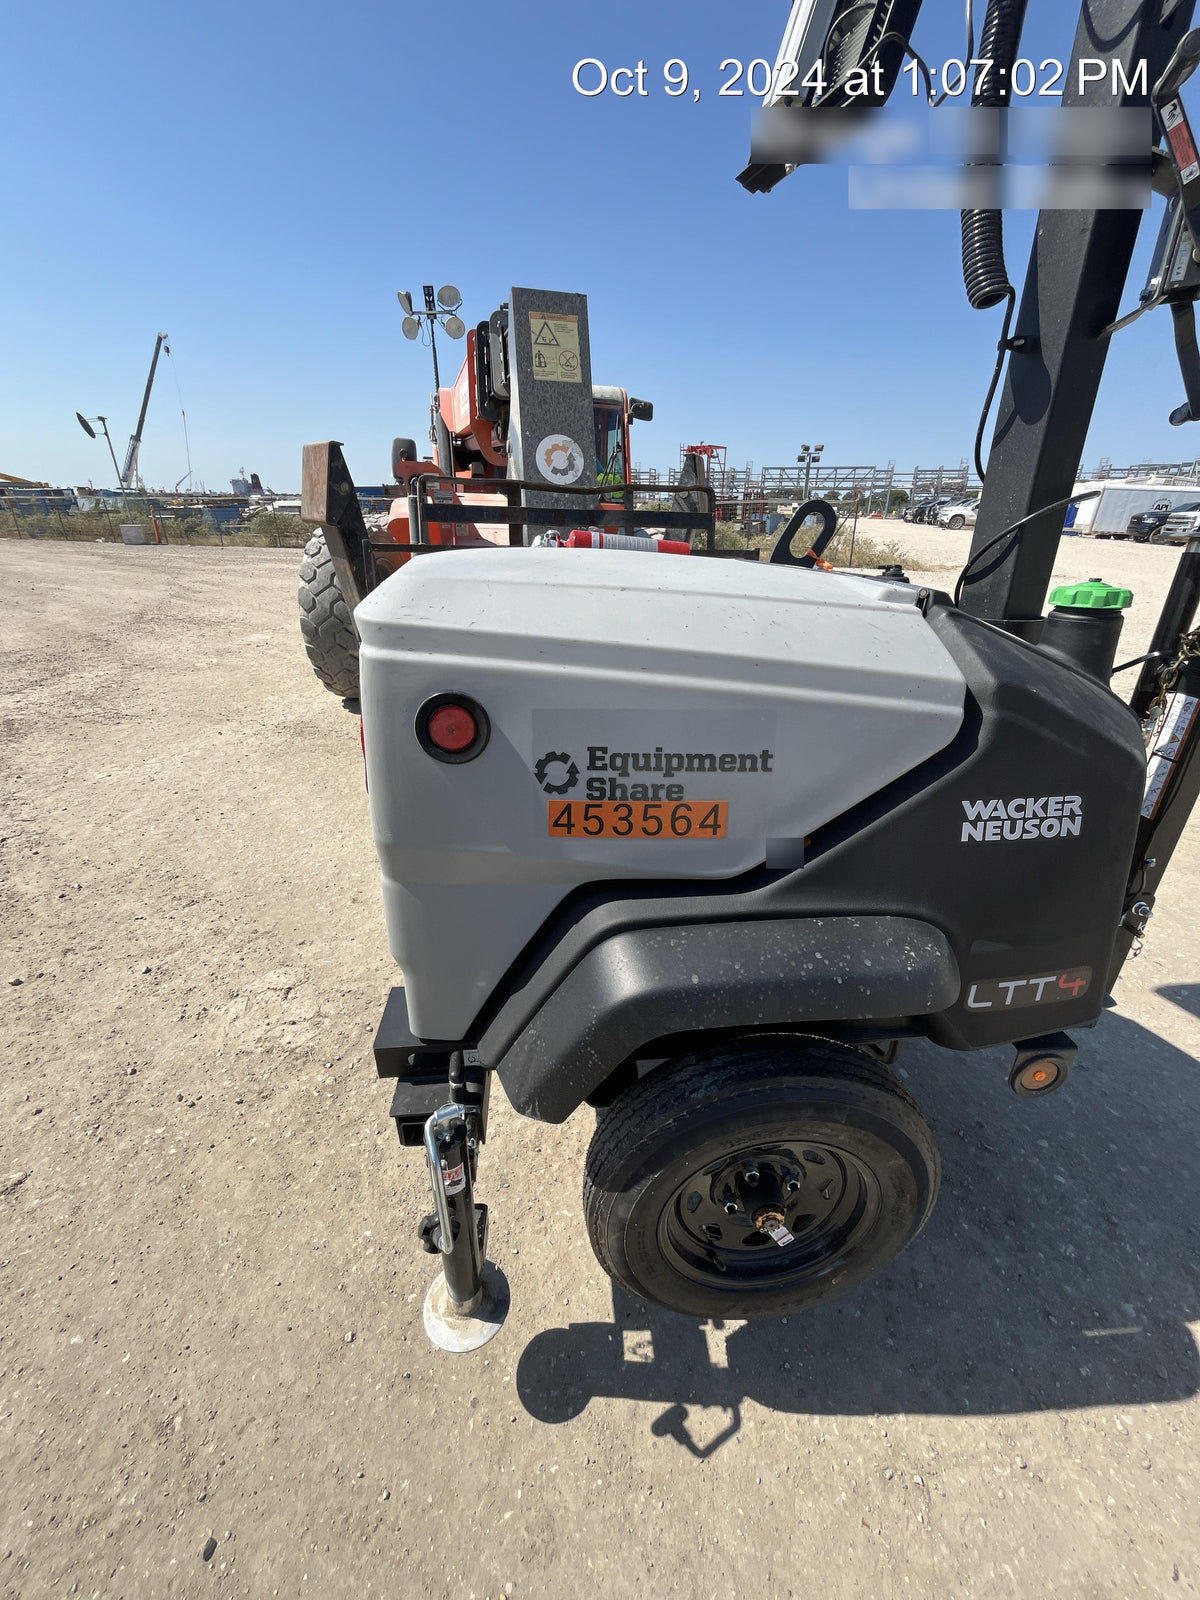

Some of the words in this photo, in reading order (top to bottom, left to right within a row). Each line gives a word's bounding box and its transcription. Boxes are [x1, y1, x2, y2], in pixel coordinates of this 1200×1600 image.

[587, 746, 774, 778] Equipment
[586, 777, 685, 801] Share
[552, 802, 722, 836] 453564
[961, 795, 1083, 821] WACKER
[960, 816, 1083, 842] NEUSON
[967, 973, 1087, 1009] LTT4
